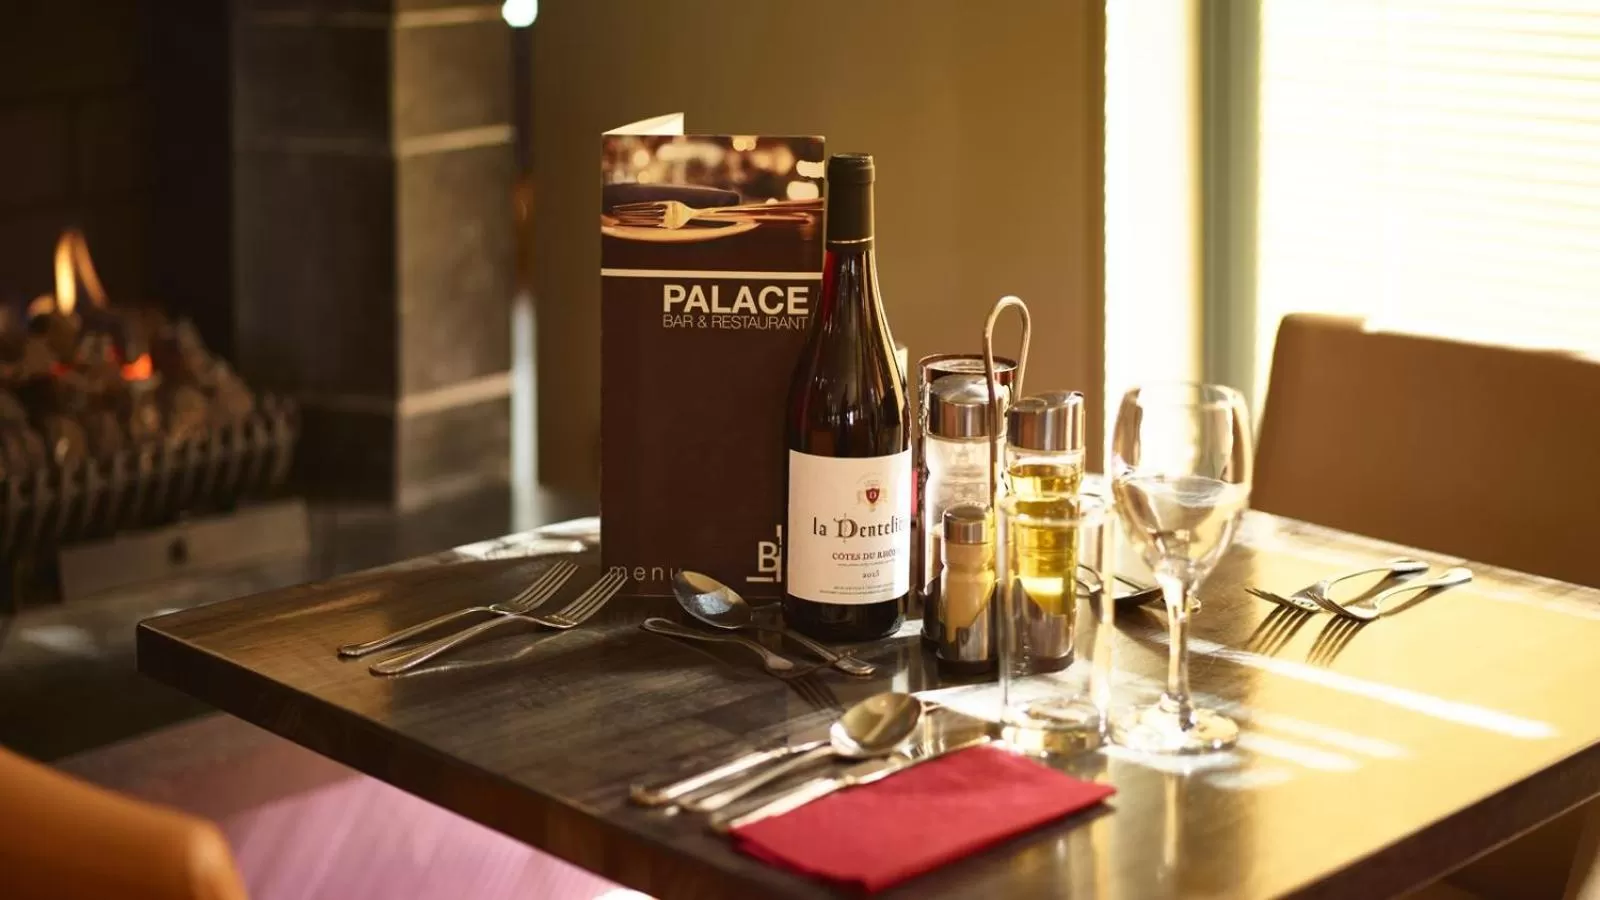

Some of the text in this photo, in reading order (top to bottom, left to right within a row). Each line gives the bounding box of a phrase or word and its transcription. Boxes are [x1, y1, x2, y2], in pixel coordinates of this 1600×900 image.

[663, 284, 809, 315] PALACE
[663, 315, 808, 330] BAR & RESTAURANT
[814, 517, 827, 536] la
